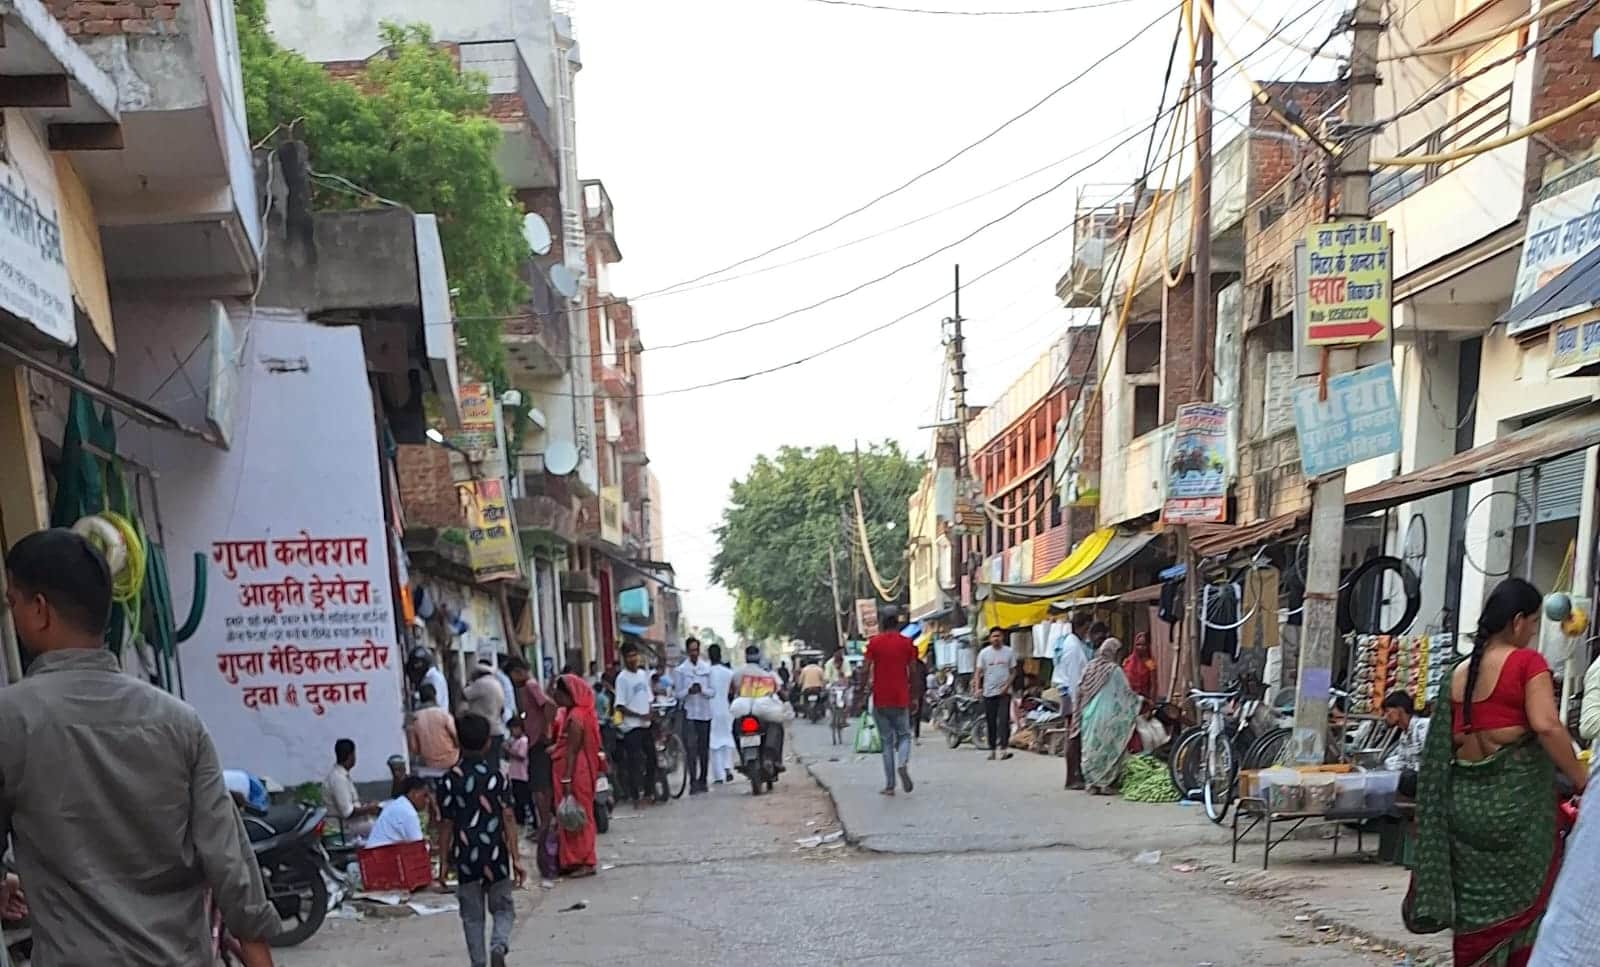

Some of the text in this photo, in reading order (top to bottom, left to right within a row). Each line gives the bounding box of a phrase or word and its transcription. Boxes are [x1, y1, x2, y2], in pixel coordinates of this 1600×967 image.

[212, 530, 367, 580] गुप्ता कलेक्शन
[240, 574, 370, 613] आकृति ड्रेसेज
[216, 640, 391, 684] गुप्ता मेडिकल स्टोर
[243, 686, 278, 711] दवा
[303, 682, 368, 716] दुकान
